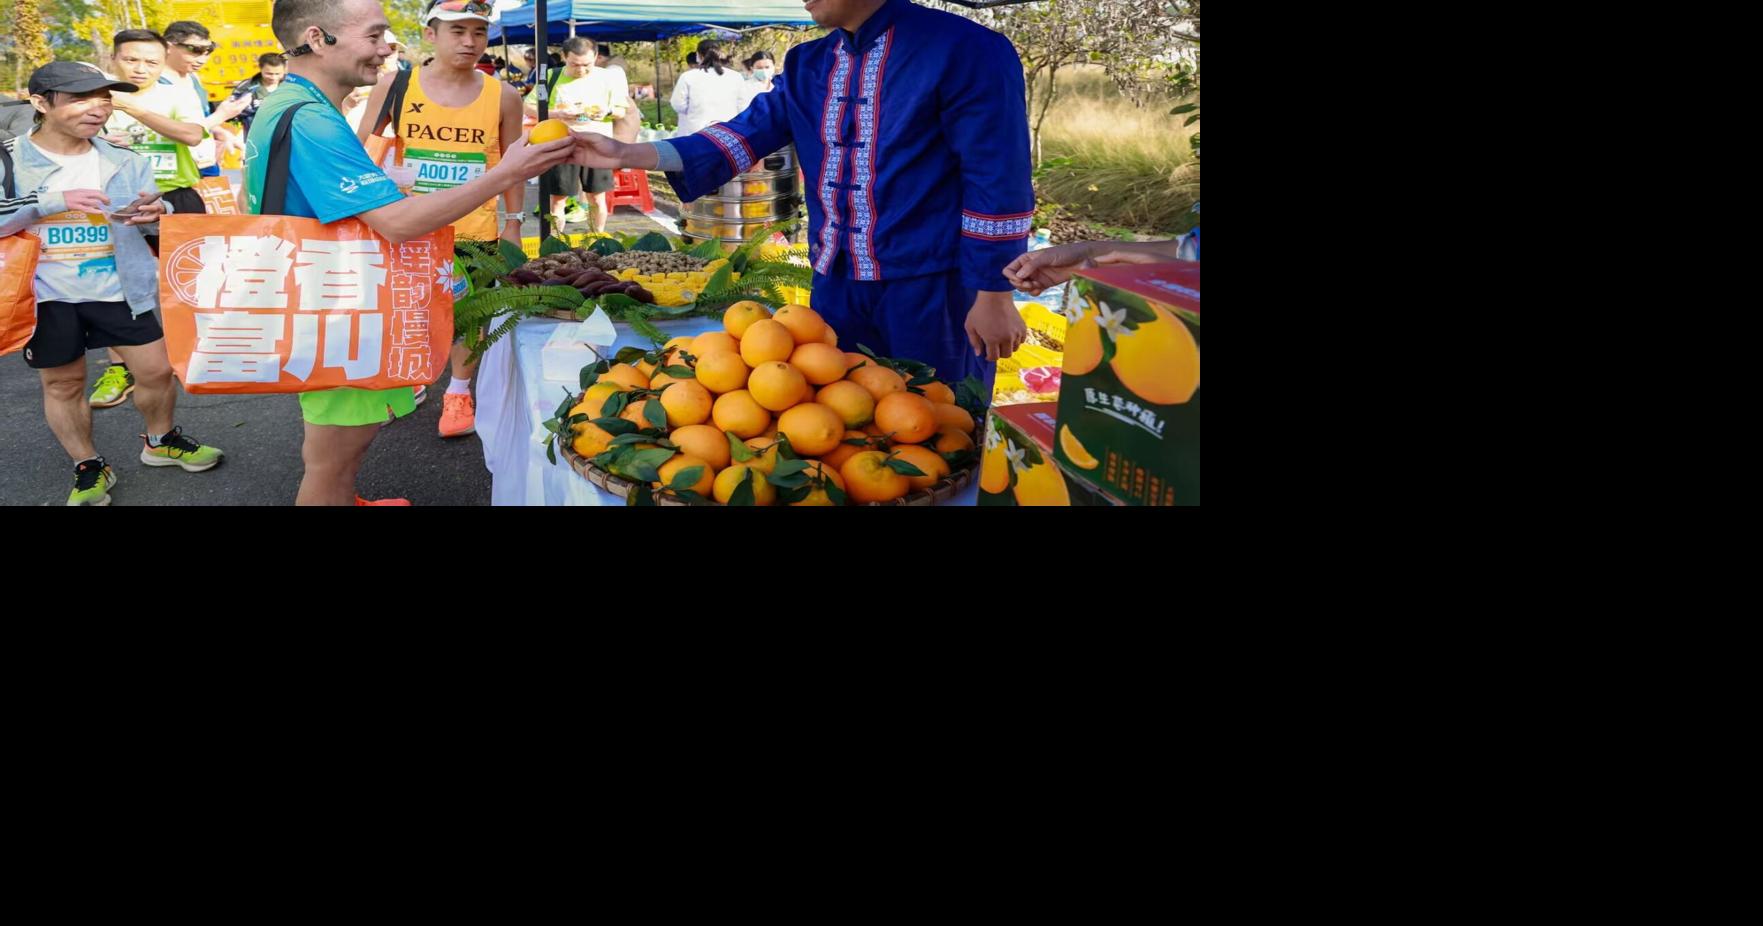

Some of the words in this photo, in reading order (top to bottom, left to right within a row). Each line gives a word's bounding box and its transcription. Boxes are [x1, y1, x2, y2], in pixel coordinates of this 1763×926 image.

[407, 123, 485, 144] PACER
[418, 163, 468, 181] A0012
[48, 226, 108, 244] B0399
[388, 240, 432, 380] 瑶韵慢城
